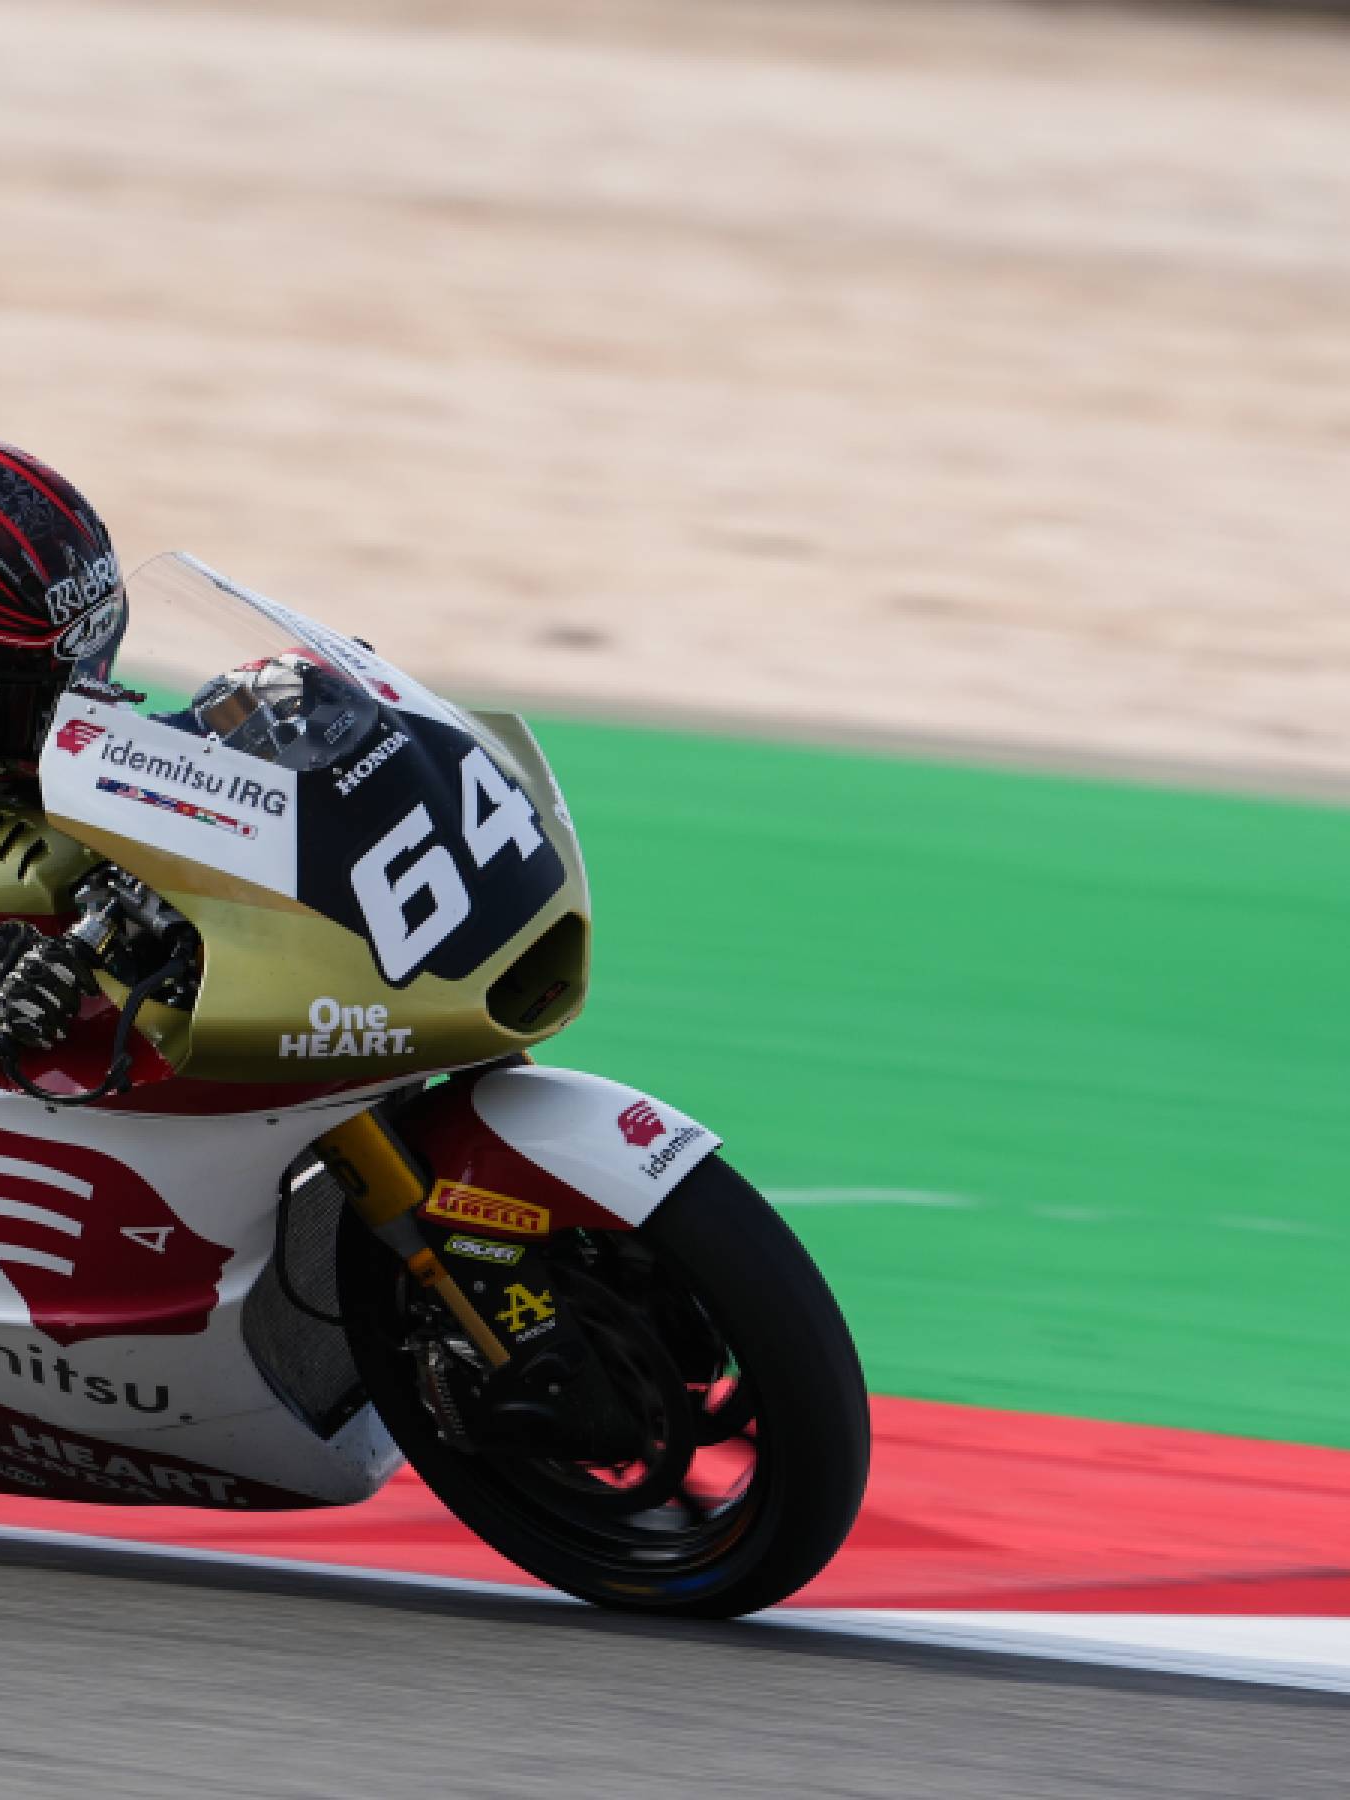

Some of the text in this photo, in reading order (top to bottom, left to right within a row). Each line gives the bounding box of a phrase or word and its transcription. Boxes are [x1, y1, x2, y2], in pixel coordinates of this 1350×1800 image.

[100, 733, 288, 817] idemitsu IRG
[335, 732, 409, 796] HONDA
[351, 746, 545, 983] 64
[309, 997, 388, 1033] One
[279, 1028, 414, 1060] HEART.
[437, 1187, 541, 1231] PIRELLI
